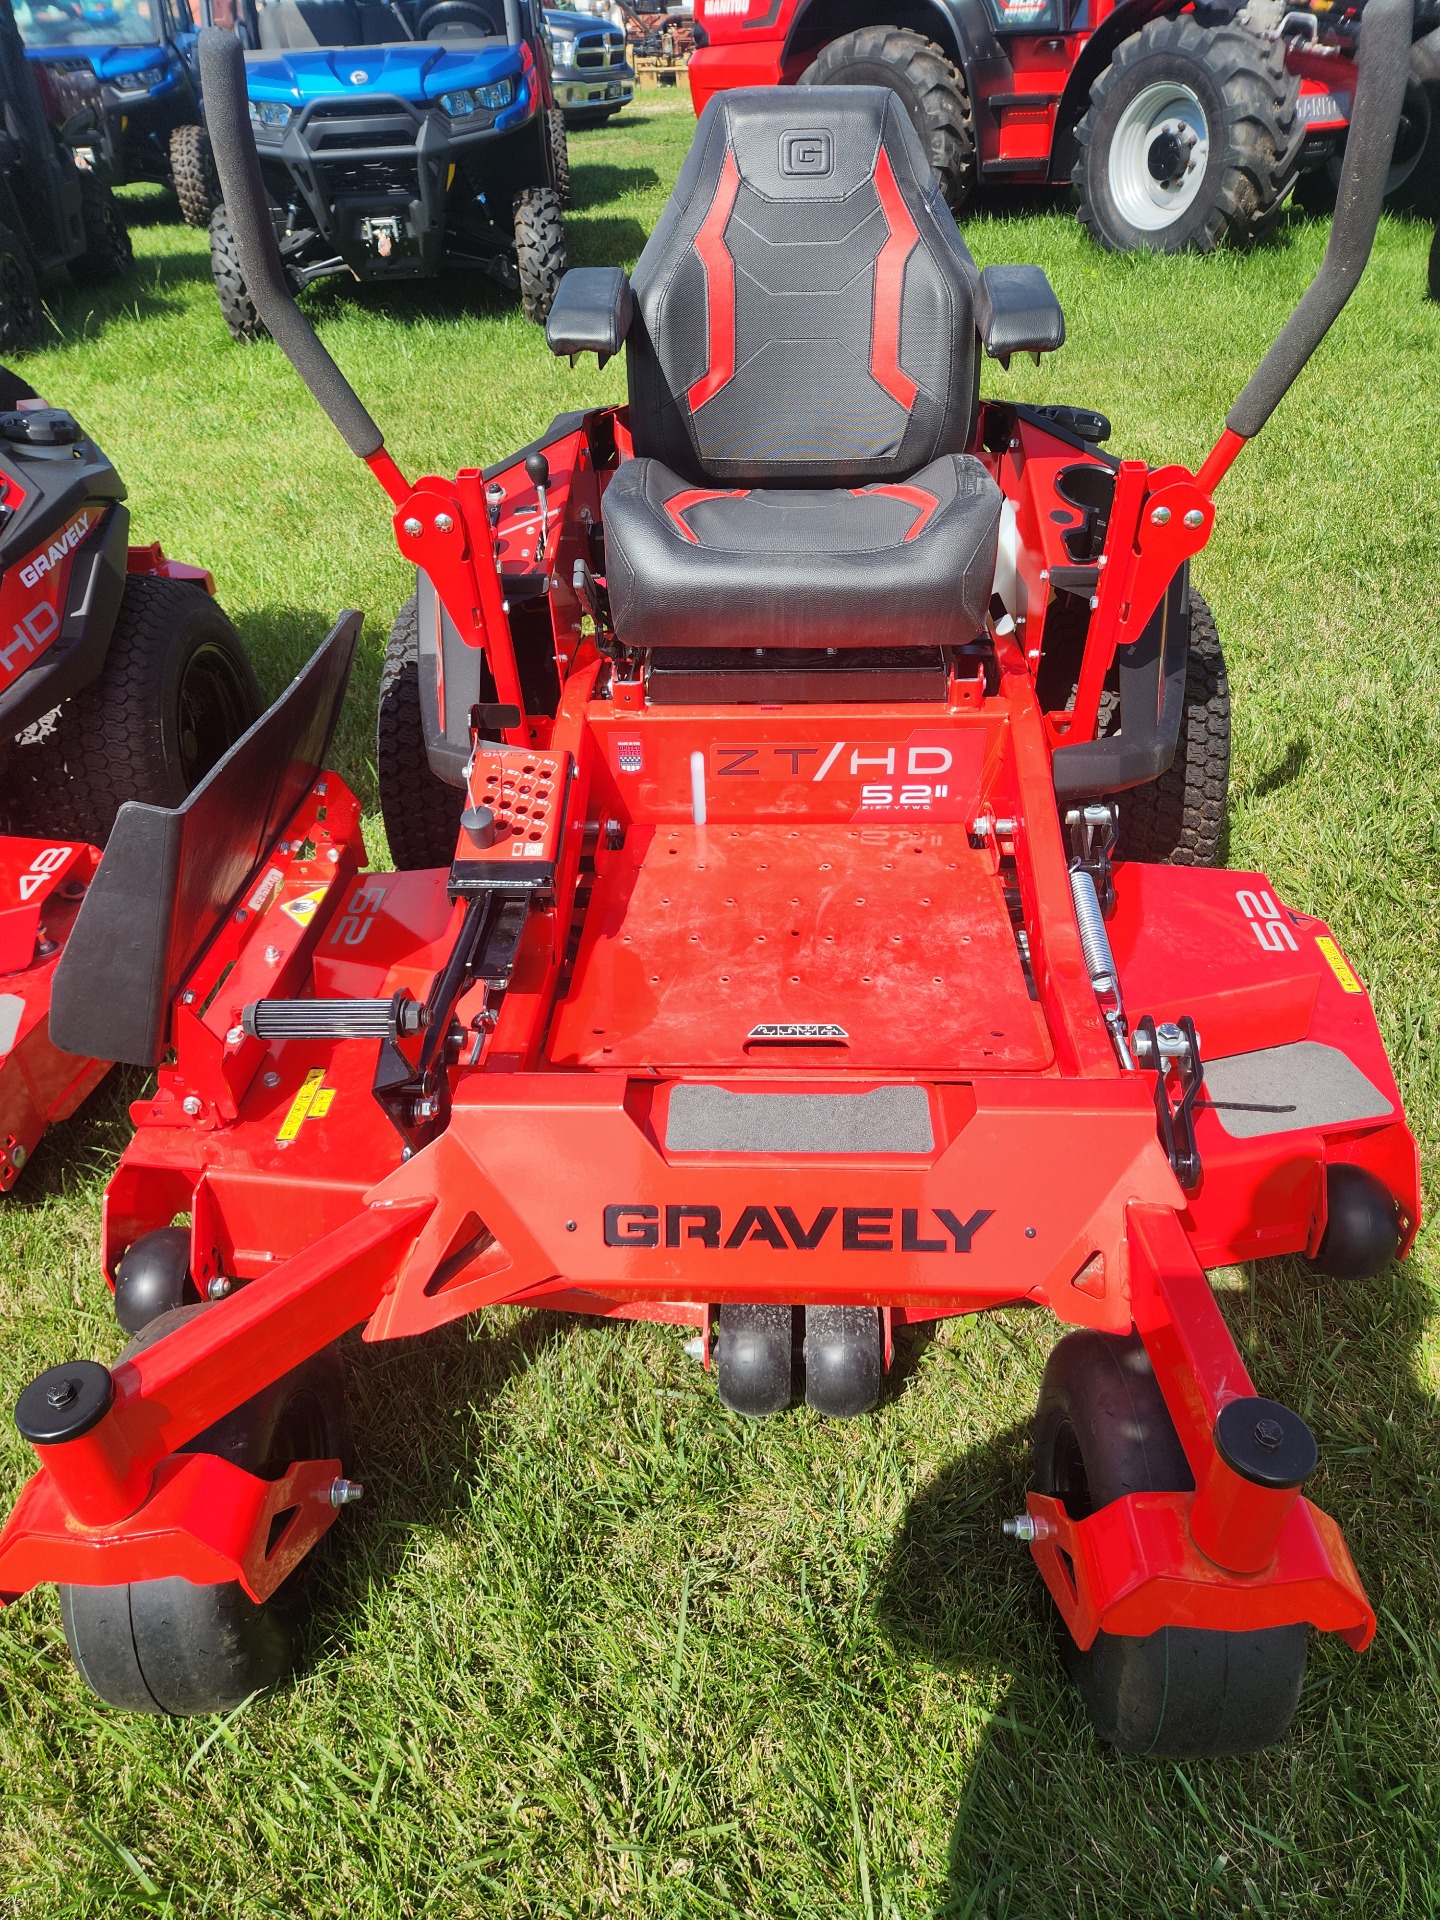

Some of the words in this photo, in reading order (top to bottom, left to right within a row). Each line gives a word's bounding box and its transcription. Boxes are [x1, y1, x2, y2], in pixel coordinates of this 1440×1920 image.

[704, 0, 750, 16] MANITOU
[19, 511, 90, 589] GRAVELY
[861, 785, 948, 804] 52"
[19, 847, 72, 900] 48
[330, 887, 387, 945] 52
[1235, 890, 1299, 951] 52
[602, 1203, 997, 1253] GRAVELY
